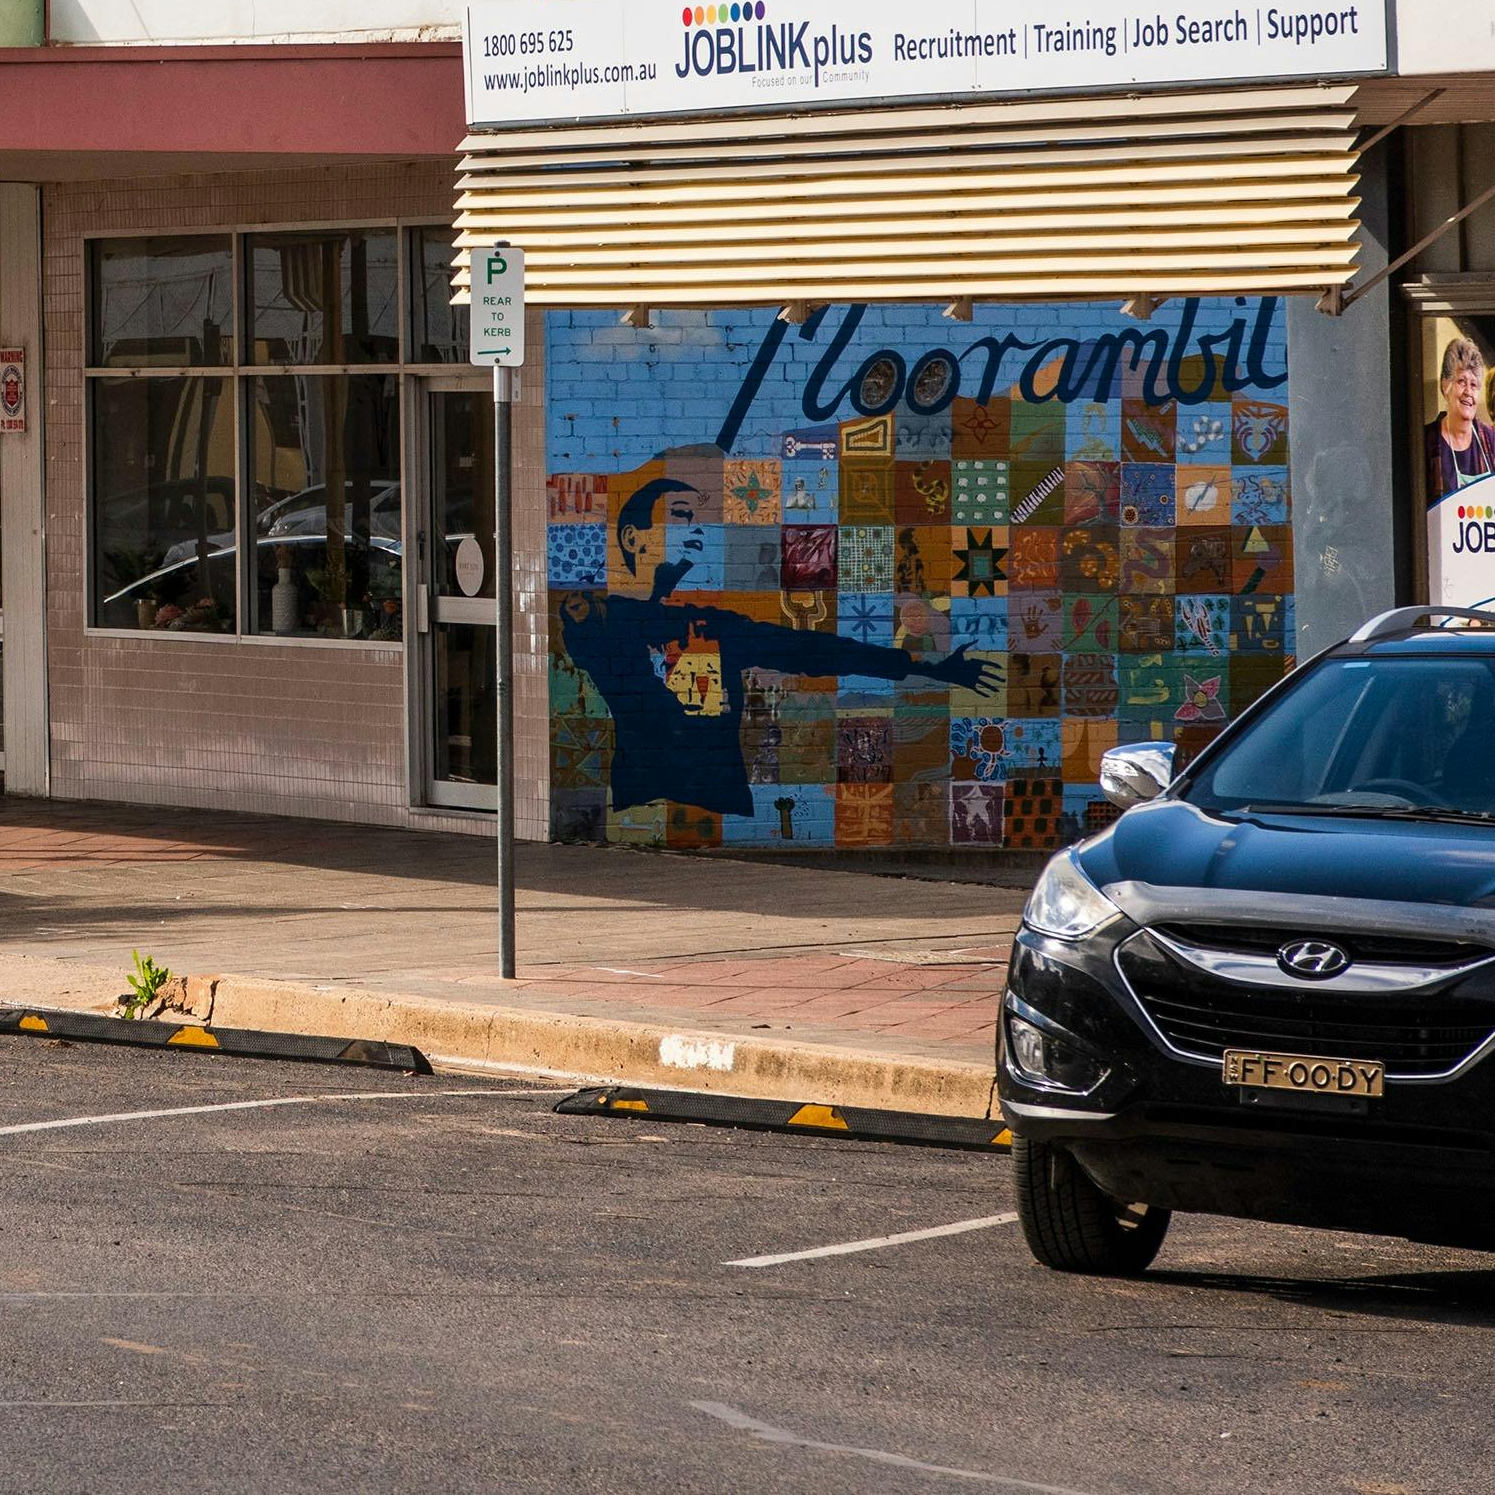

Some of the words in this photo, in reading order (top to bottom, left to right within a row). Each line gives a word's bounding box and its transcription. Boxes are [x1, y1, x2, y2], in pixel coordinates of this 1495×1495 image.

[483, 34, 516, 57] 1800
[519, 31, 546, 55] 695
[548, 29, 574, 53] 625
[894, 28, 1017, 61] Recruitment
[1034, 19, 1116, 56] Training
[1132, 16, 1169, 48] Job
[1175, 9, 1247, 45] Search
[1267, 5, 1359, 46] Support
[483, 60, 657, 93] www.joblinkplus.com.au
[751, 75, 785, 88] Focused
[787, 75, 797, 86] on
[799, 74, 813, 85] our
[822, 70, 870, 84] Community
[487, 257, 508, 284] P
[483, 296, 512, 306] REAR
[491, 312, 505, 321] TO
[483, 327, 512, 337] KERB
